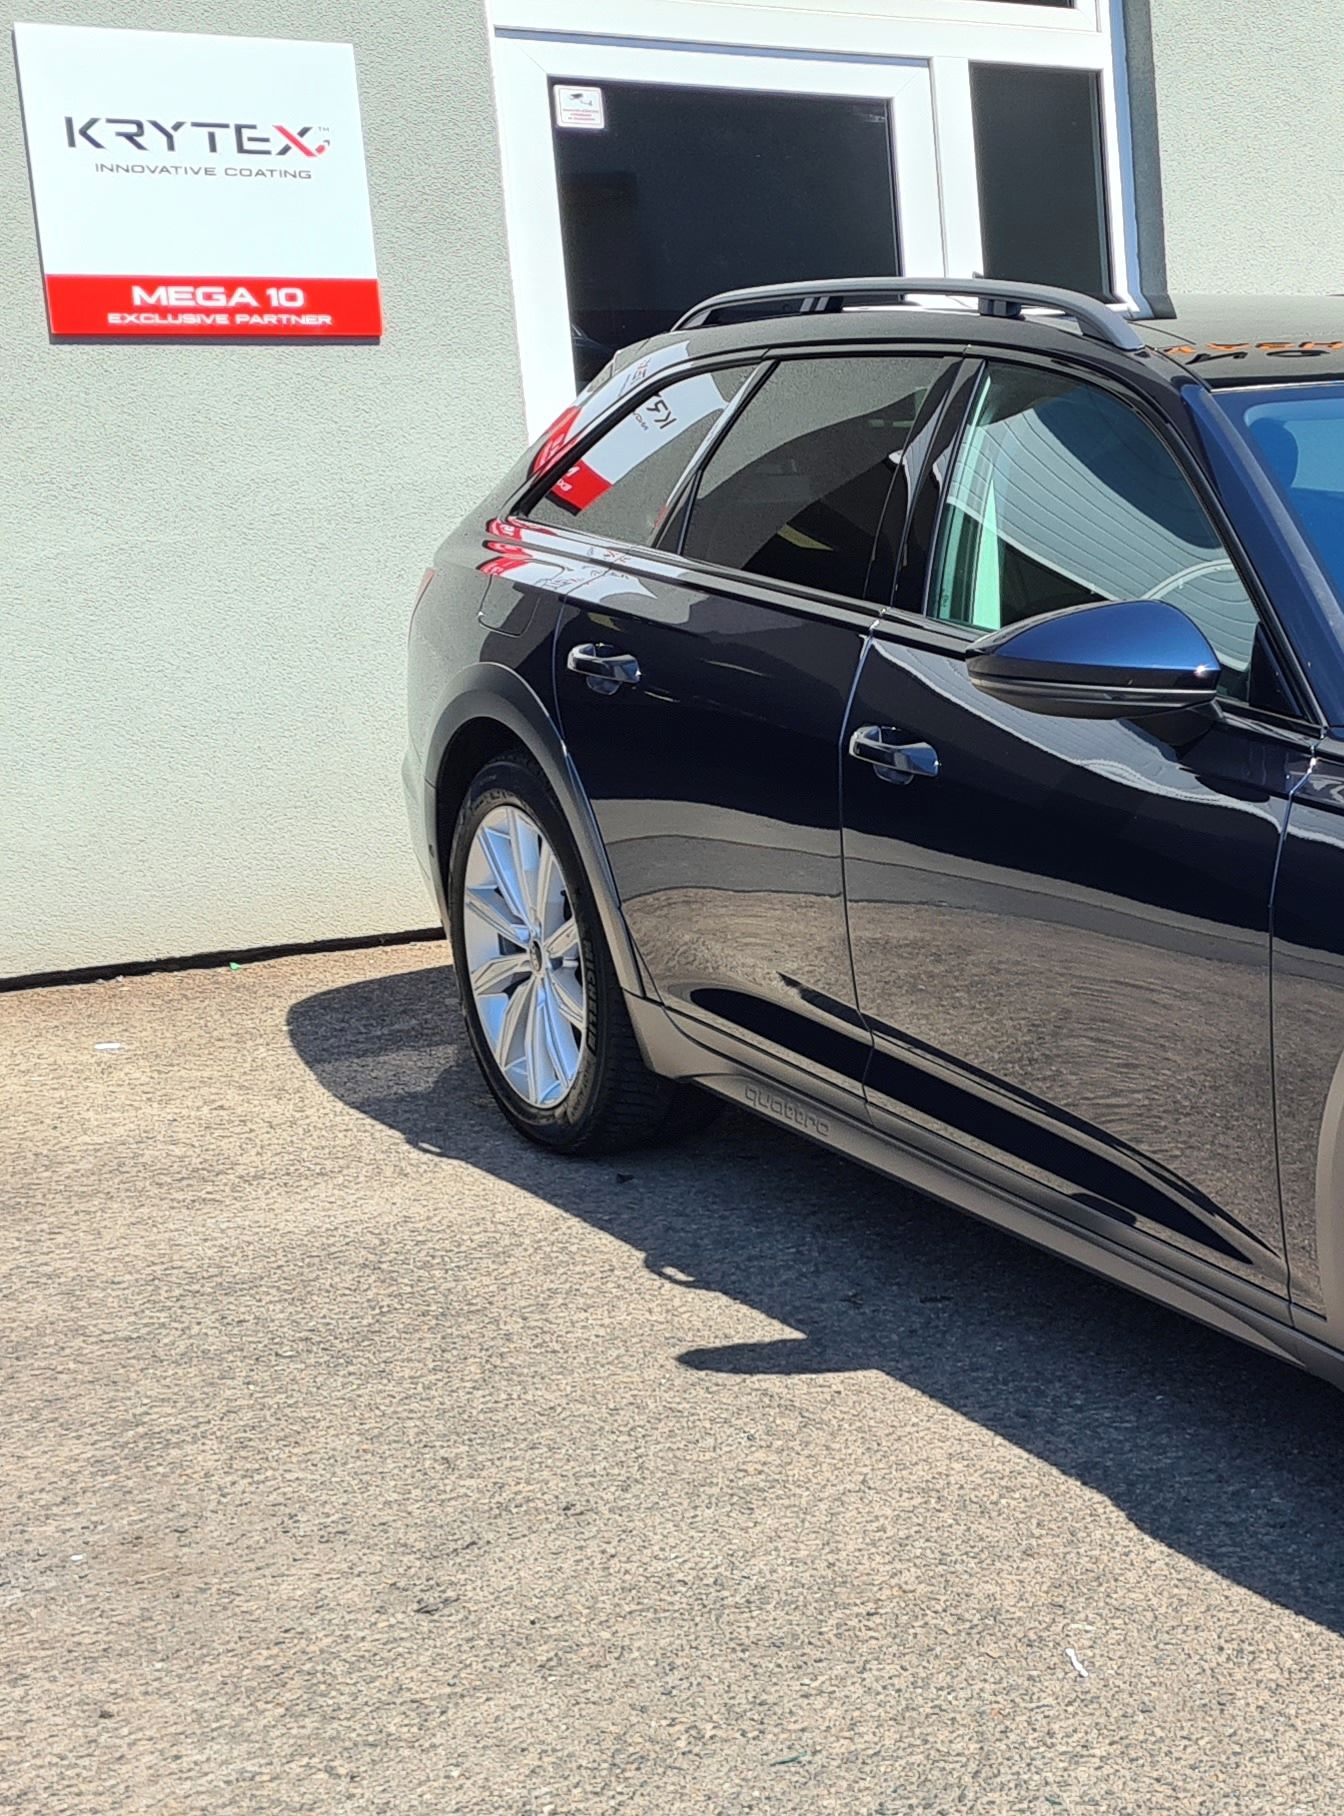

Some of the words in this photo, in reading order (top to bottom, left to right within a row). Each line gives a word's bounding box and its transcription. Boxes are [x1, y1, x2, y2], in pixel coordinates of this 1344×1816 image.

[64, 116, 322, 158] KRYTEX
[95, 163, 217, 176] INNOVATIVE
[224, 167, 312, 179] COATING
[131, 284, 260, 308] MEGA
[265, 286, 305, 308] 10
[107, 312, 230, 325] EXCLUSIVE
[235, 314, 333, 326] PARTNER
[744, 1084, 830, 1137] quattro
